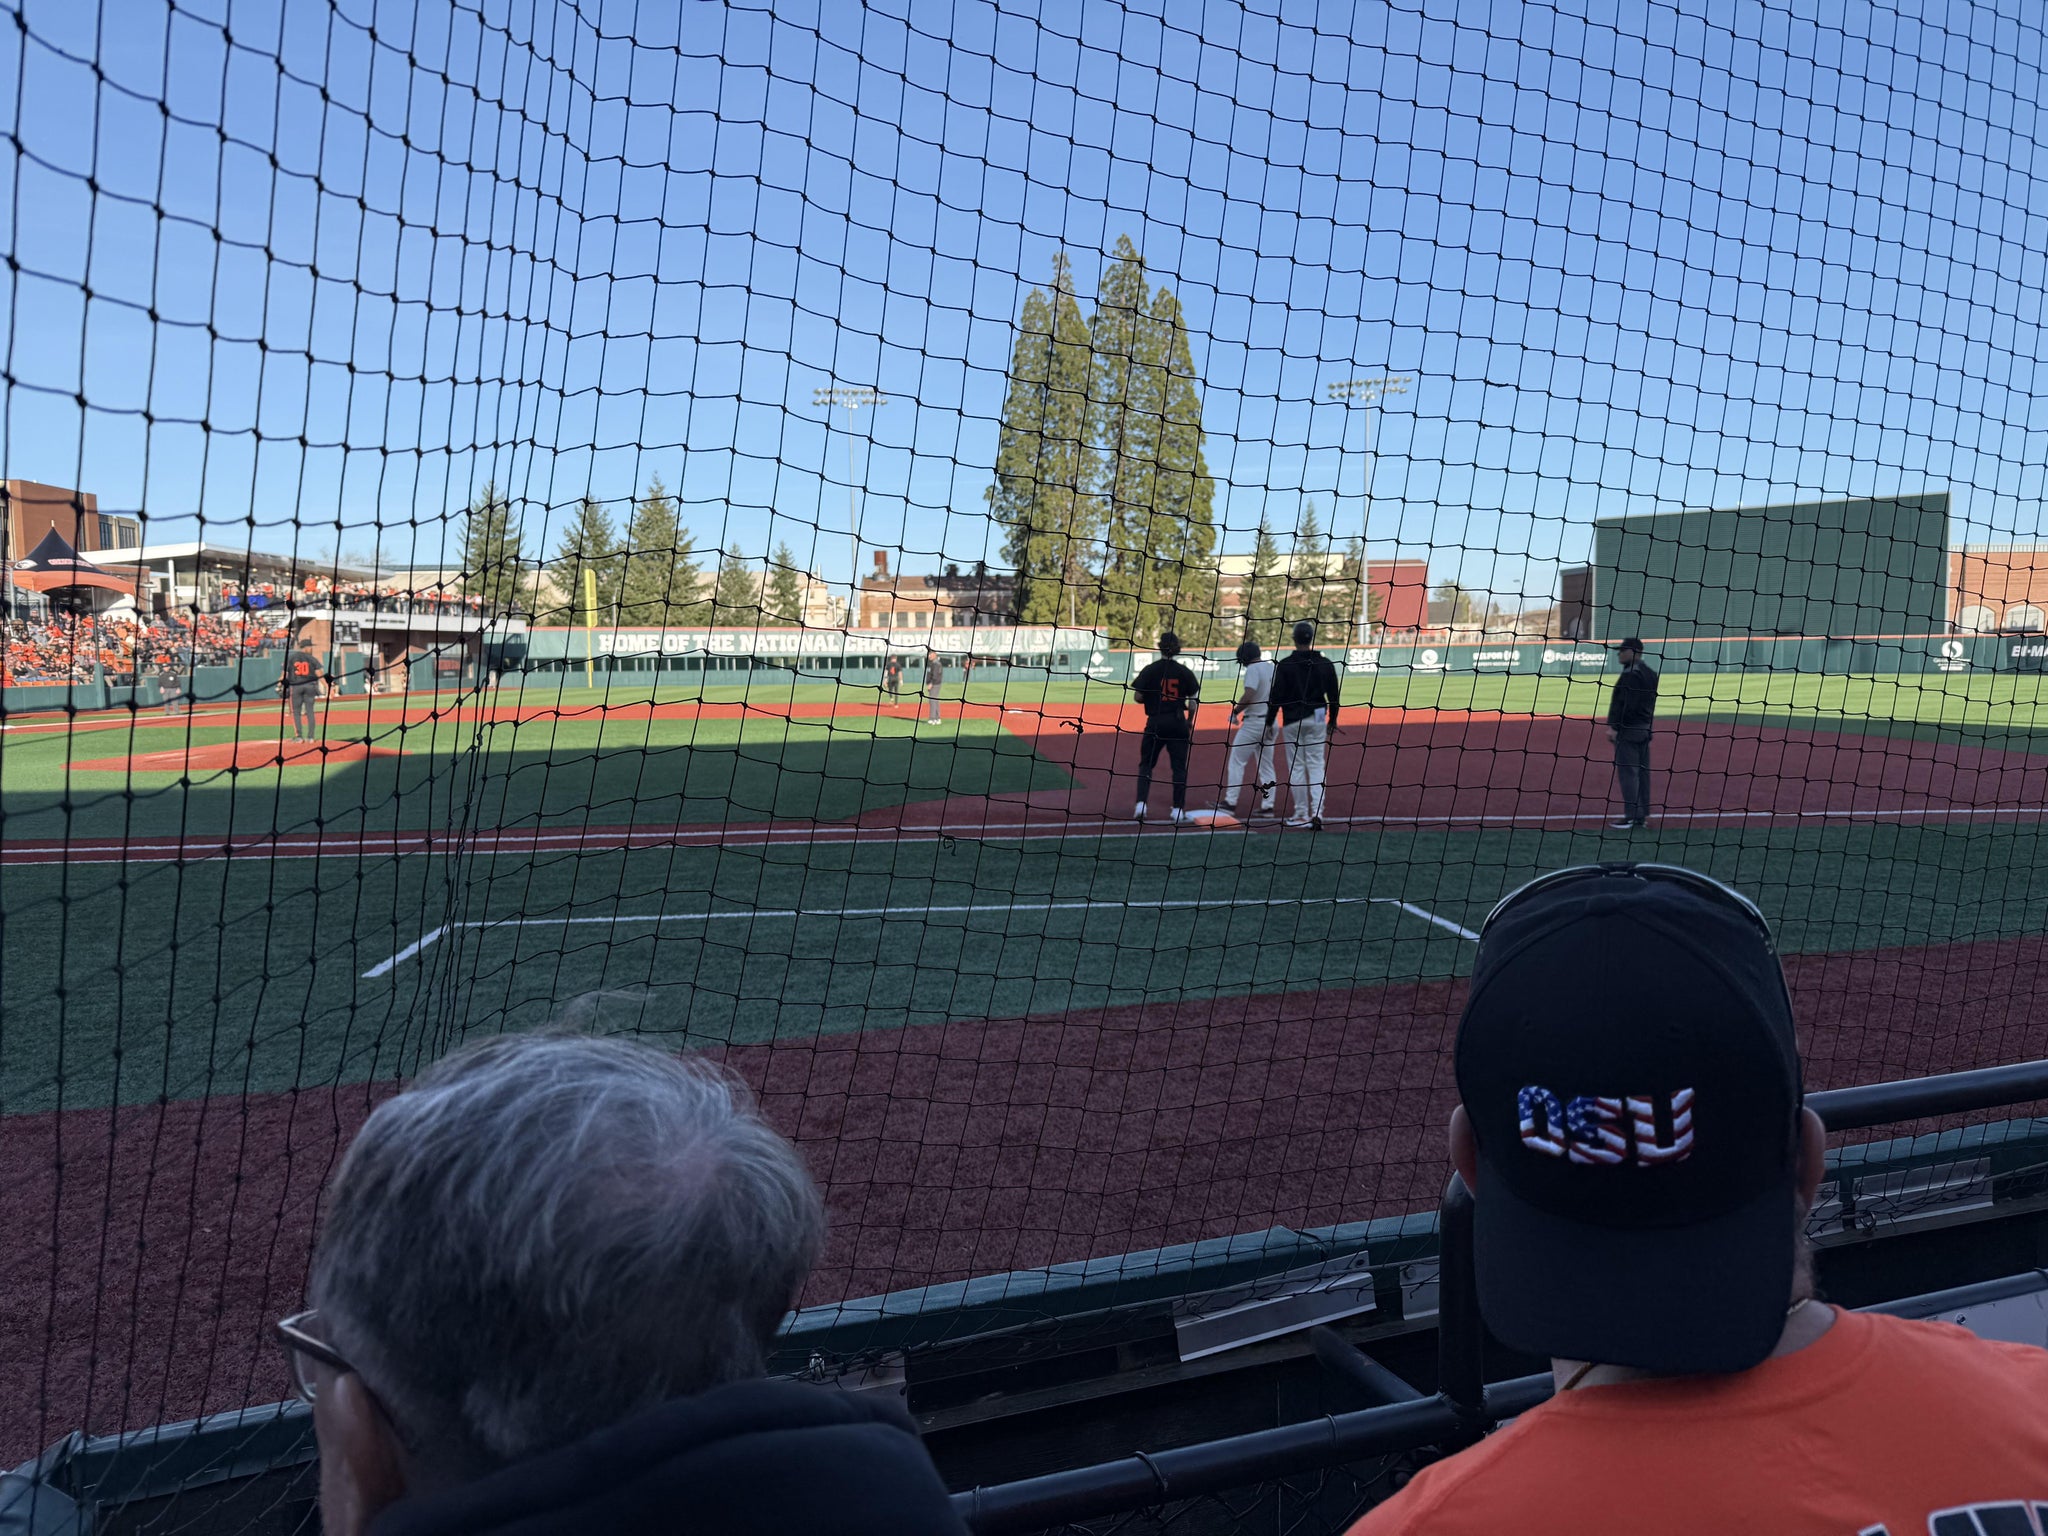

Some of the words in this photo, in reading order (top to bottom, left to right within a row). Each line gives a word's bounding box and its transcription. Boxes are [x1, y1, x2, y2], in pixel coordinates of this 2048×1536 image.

[598, 634, 660, 652] HOME
[663, 634, 690, 652] OF
[692, 634, 735, 652] THE
[739, 634, 840, 652] NATIONAL
[844, 634, 961, 652] CHAMPIONS
[1349, 648, 1379, 661] SEAT
[293, 661, 310, 676] 30
[1161, 678, 1180, 702] 15
[1517, 1085, 1695, 1167] OSU
